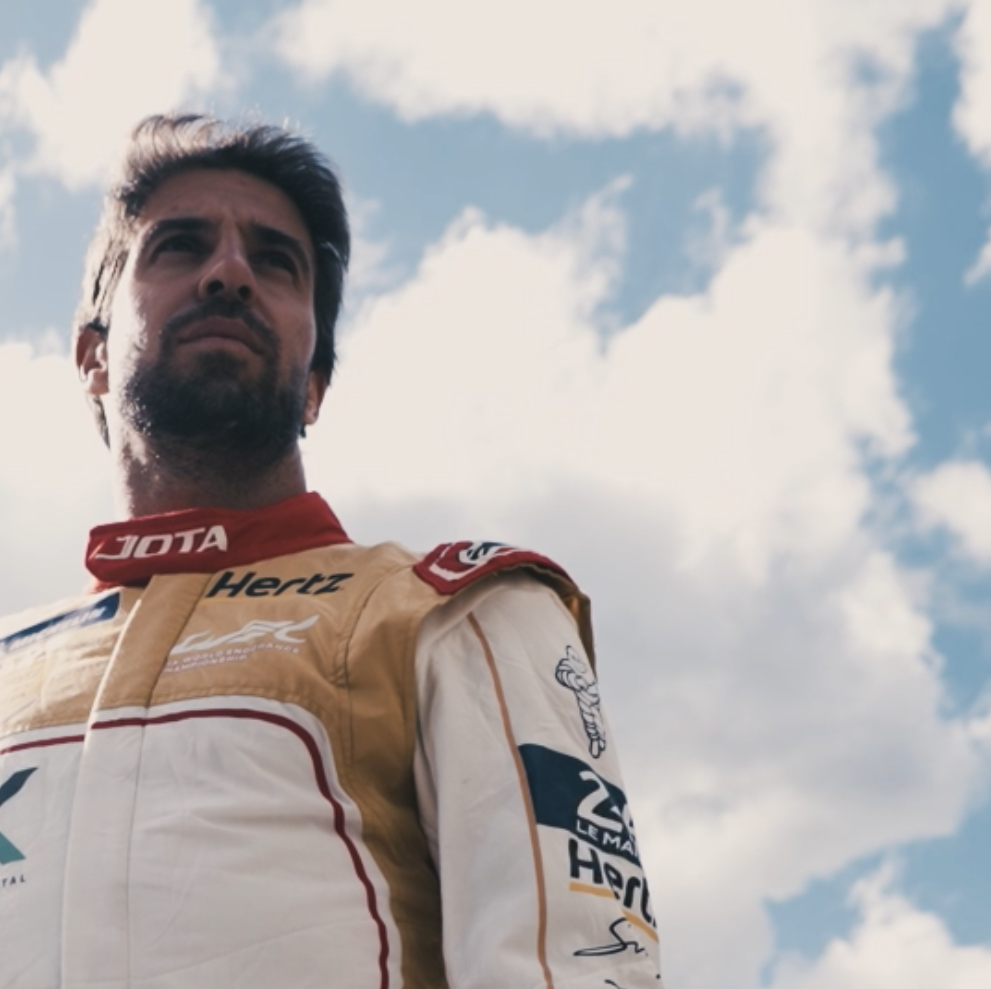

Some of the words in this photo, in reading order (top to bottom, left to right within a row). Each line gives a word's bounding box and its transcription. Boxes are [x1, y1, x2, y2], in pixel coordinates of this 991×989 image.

[95, 525, 228, 559] JOTA
[205, 571, 354, 598] Hertz
[576, 819, 599, 841] LE
[603, 831, 638, 858] MA
